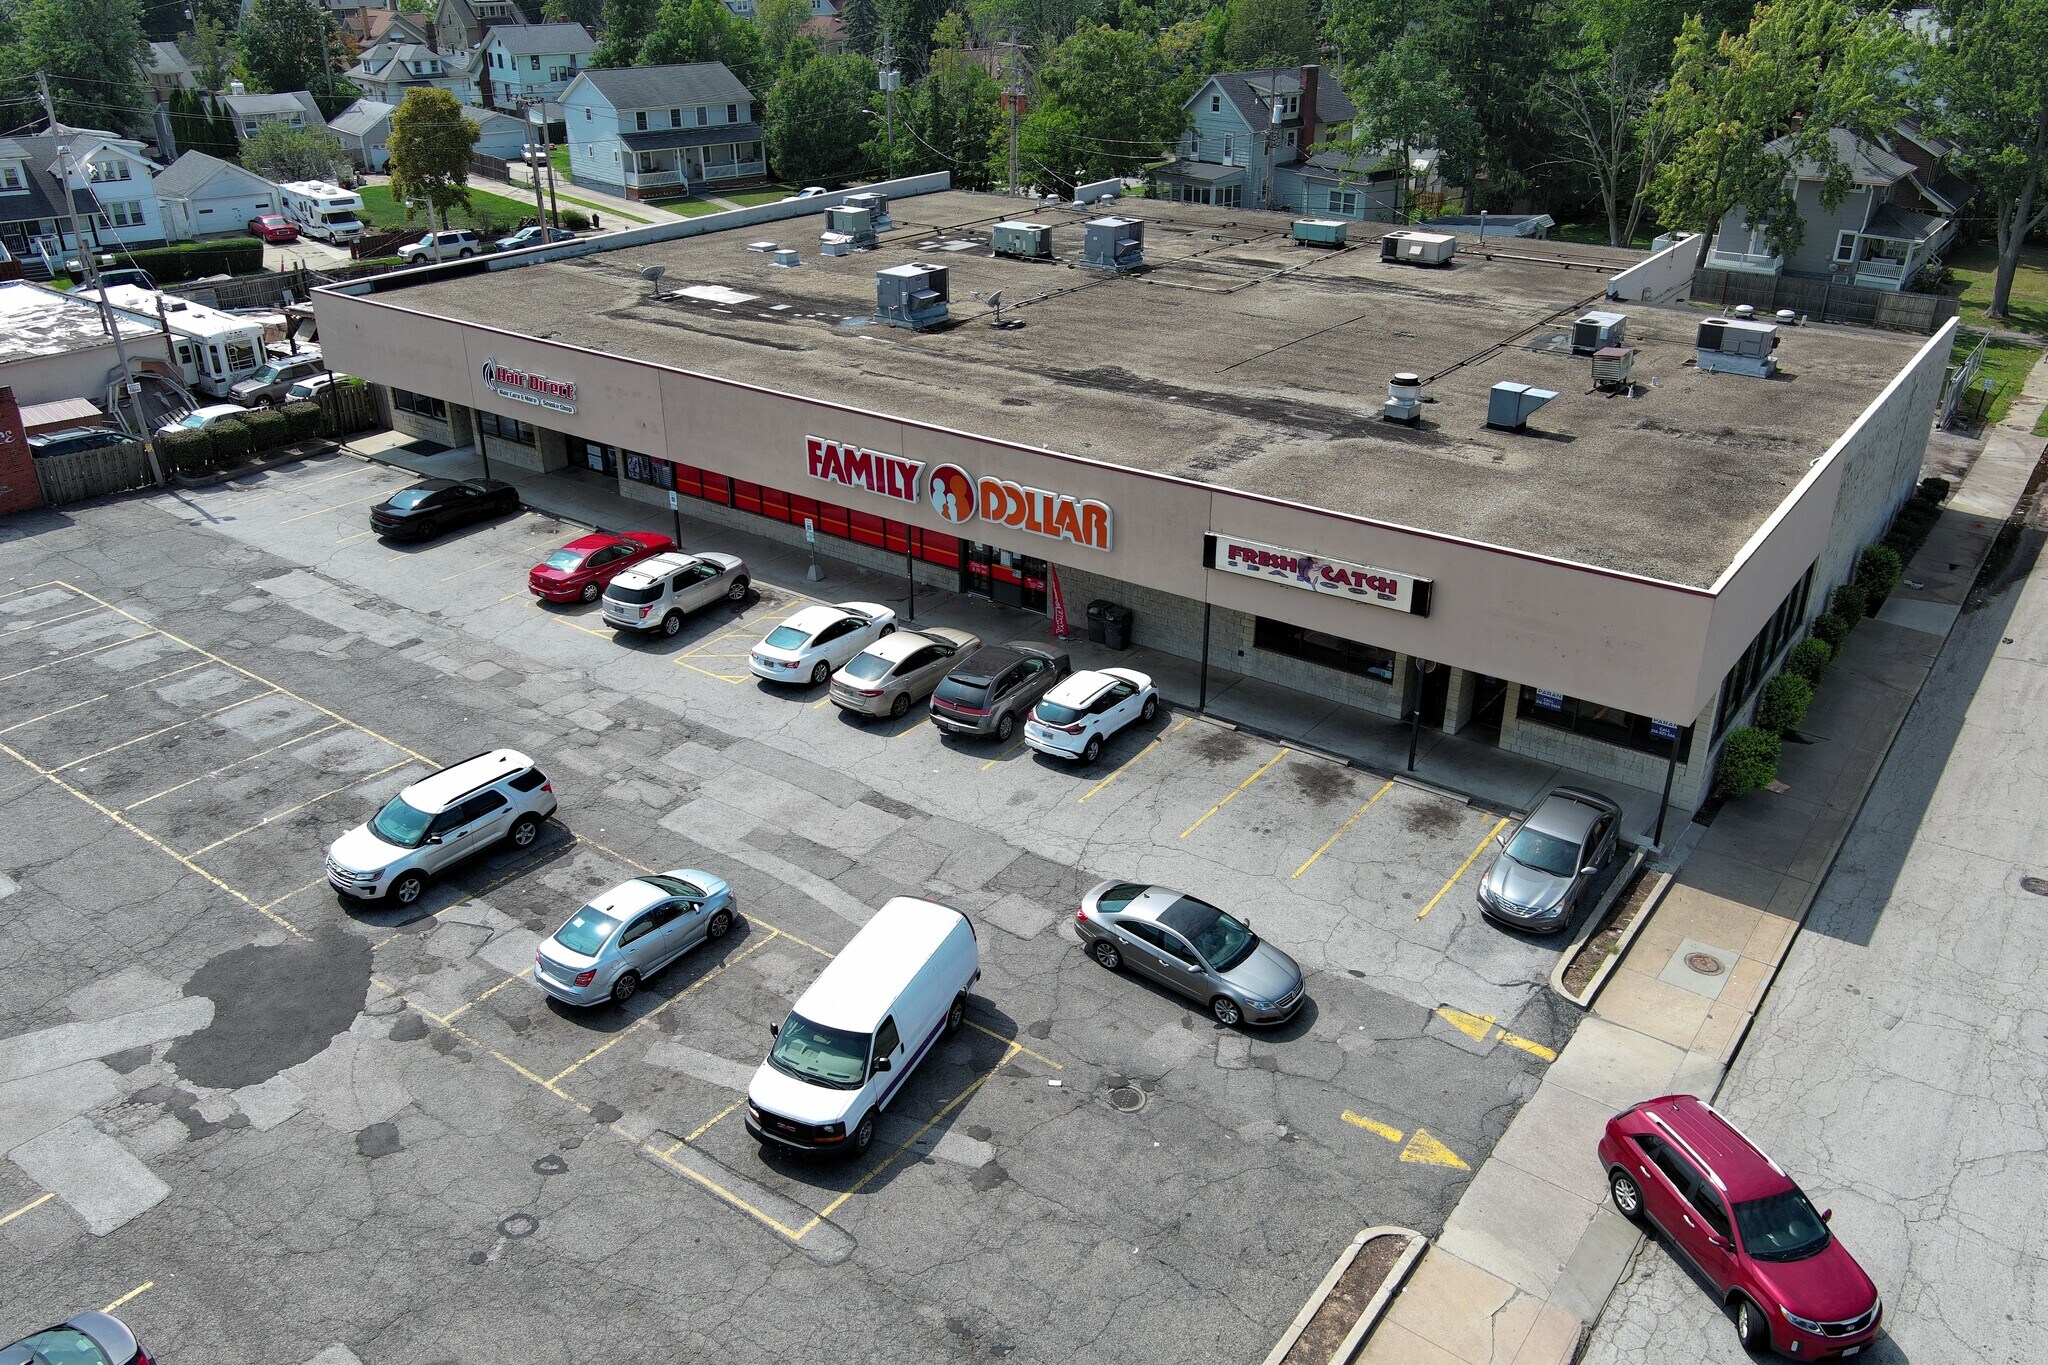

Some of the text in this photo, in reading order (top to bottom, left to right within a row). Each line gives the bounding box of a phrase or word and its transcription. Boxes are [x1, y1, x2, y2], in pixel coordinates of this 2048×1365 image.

[496, 365, 574, 398] Hair Direct
[543, 400, 573, 413] Smoke Shop
[806, 436, 1112, 550] FAMILY DOLLAR
[1228, 544, 1397, 596] FRESH CATCH
[1537, 688, 1562, 699] PARAN
